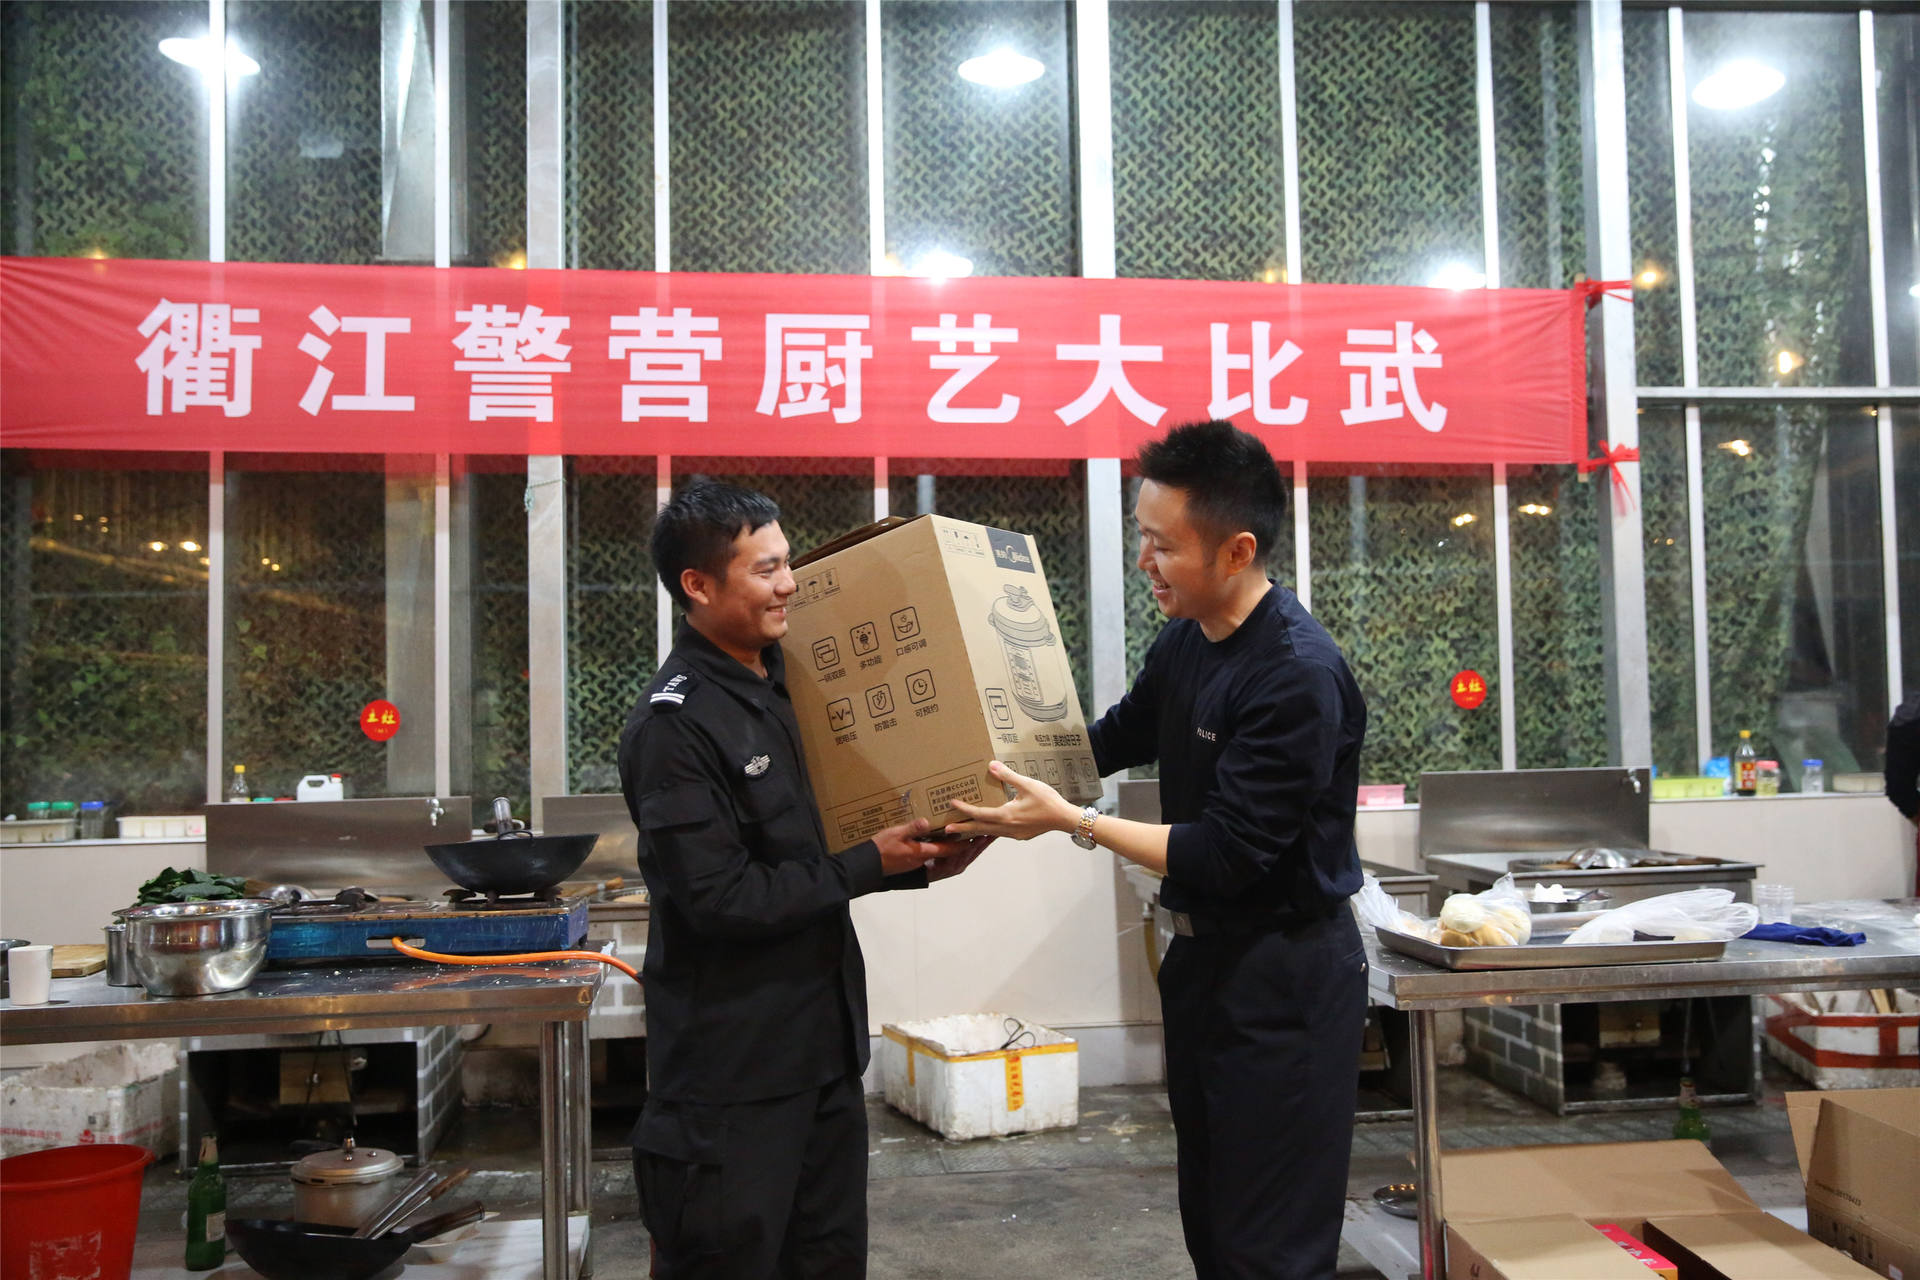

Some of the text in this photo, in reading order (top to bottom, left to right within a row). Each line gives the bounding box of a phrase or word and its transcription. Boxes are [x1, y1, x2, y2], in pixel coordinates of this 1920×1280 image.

[135, 297, 1448, 433] 衢江警营厨艺大比武
[896, 638, 927, 656] 口感可调
[860, 655, 882, 670] 多功能
[914, 703, 939, 718] 可预约
[873, 718, 898, 733] 防雷击
[1196, 726, 1217, 742] POLICE
